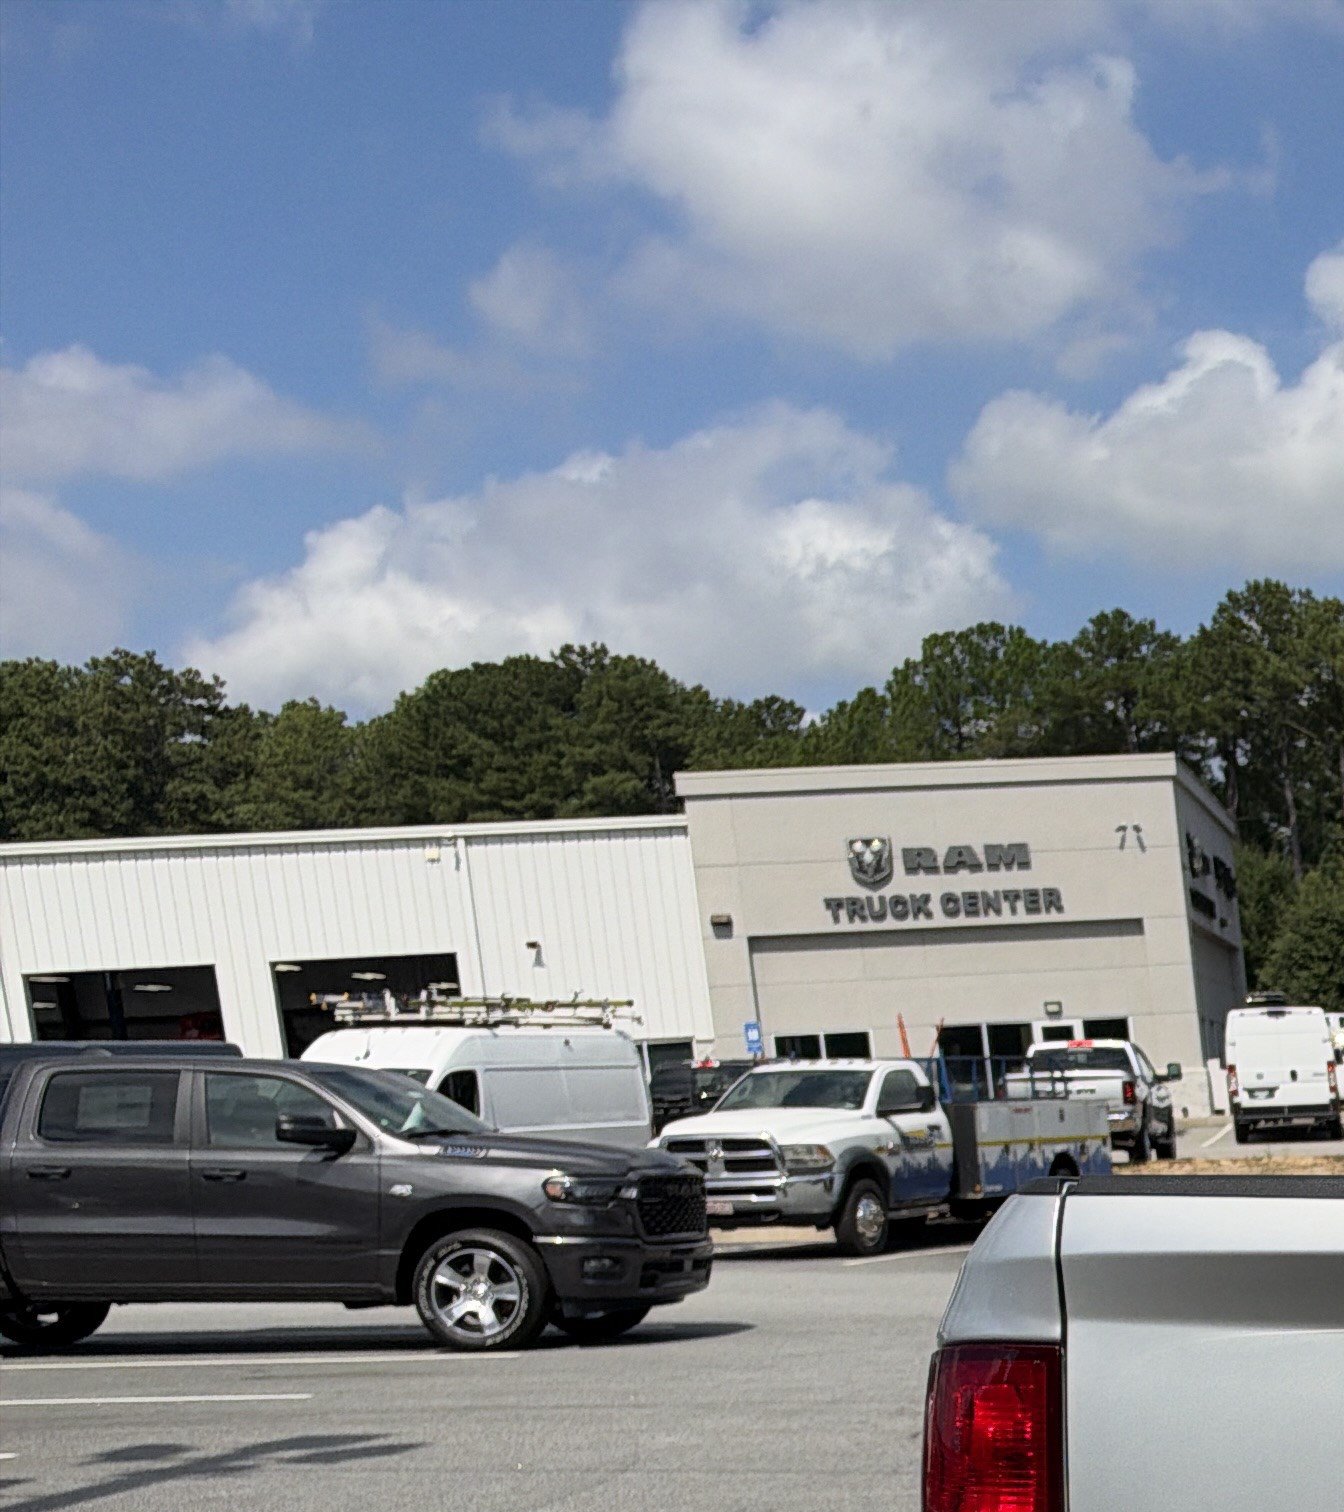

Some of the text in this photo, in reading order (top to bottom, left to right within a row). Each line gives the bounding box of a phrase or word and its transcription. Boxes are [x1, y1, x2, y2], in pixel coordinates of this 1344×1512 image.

[902, 843, 1032, 875] RAM
[824, 887, 1065, 925] TRUCK CENTER
